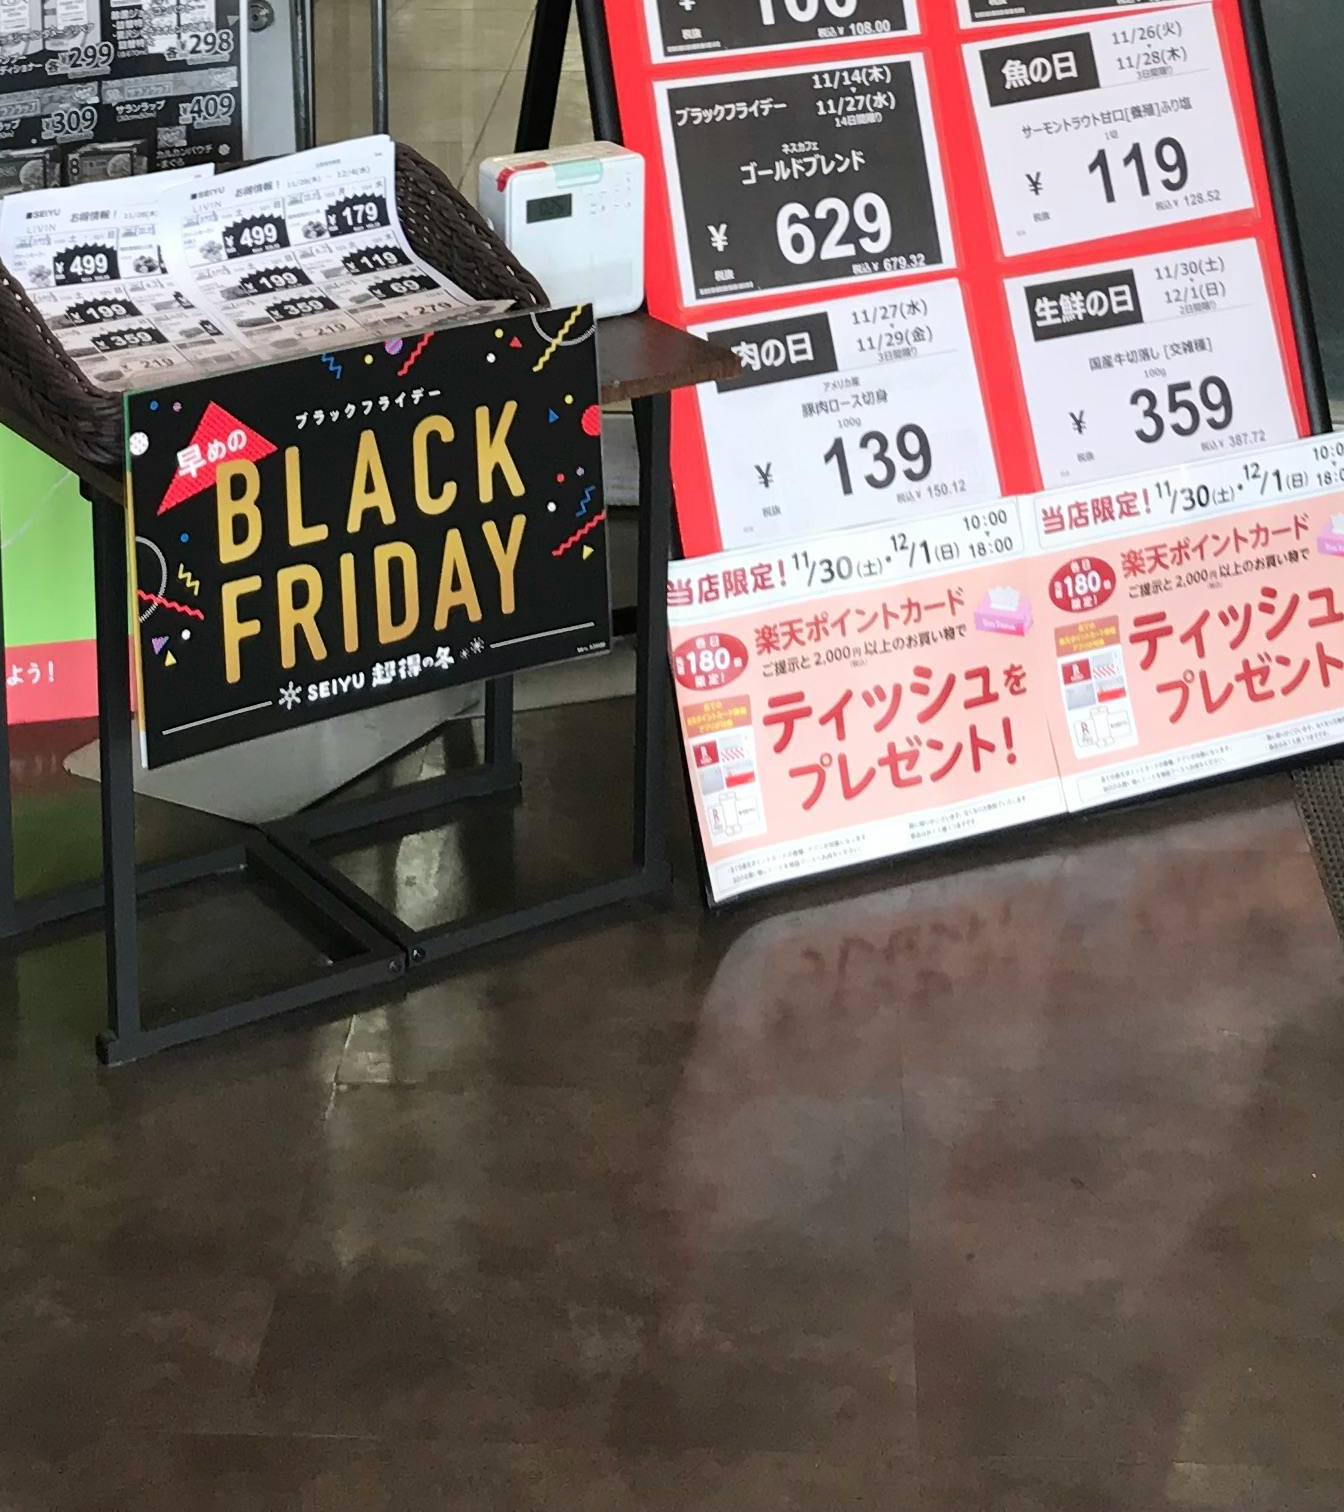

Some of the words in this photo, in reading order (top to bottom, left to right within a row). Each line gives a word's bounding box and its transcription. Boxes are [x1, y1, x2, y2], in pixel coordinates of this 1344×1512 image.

[1112, 21, 1183, 46] 11/26(火)
[1001, 50, 1078, 89] 魚の日
[1117, 46, 1188, 71] 11/28(木)
[812, 66, 892, 89] 11/14(木)
[116, 100, 165, 116] サランラップ
[676, 100, 788, 126] ブラックフライデー
[816, 93, 896, 116] 11/27(水)
[782, 141, 819, 154] ネスカフェ
[740, 150, 865, 186] ゴールドブレンド
[1089, 136, 1189, 203] 119
[1182, 190, 1221, 207] 128.52
[776, 191, 893, 265] 629
[1154, 257, 1226, 280] 11/30(土)
[1164, 280, 1227, 304] 12/1(日)
[852, 299, 928, 324] 11/27(水)
[1034, 285, 1135, 328] 生鮮の日
[856, 326, 933, 353] 11/29(金)
[1143, 367, 1167, 380] 100g
[295, 388, 442, 429] ブラックフライデー
[801, 389, 888, 418] 豚肉ロース切身
[1130, 375, 1232, 445] 359
[836, 417, 861, 429] 100g
[1228, 430, 1266, 448] 387.72
[176, 427, 248, 480] 早めの
[824, 423, 932, 496] 139
[214, 399, 527, 565] BLACK
[925, 480, 966, 498] 150.12
[963, 510, 1008, 531] 10:00
[1041, 487, 1150, 535] 当店限定!
[968, 537, 1013, 558] 18:00
[1121, 513, 1310, 578] 楽天ポイントカード
[667, 563, 787, 607] 当店限定!
[1064, 575, 1098, 596] 180
[221, 513, 527, 685] FRIDAY
[755, 587, 965, 655] 楽天ポイントカード
[686, 648, 730, 672] 180
[307, 671, 365, 703] SEIYU
[371, 646, 455, 687] 超得の冬
[763, 664, 1027, 753] ティッシュを
[789, 717, 1017, 810] プレゼント!
